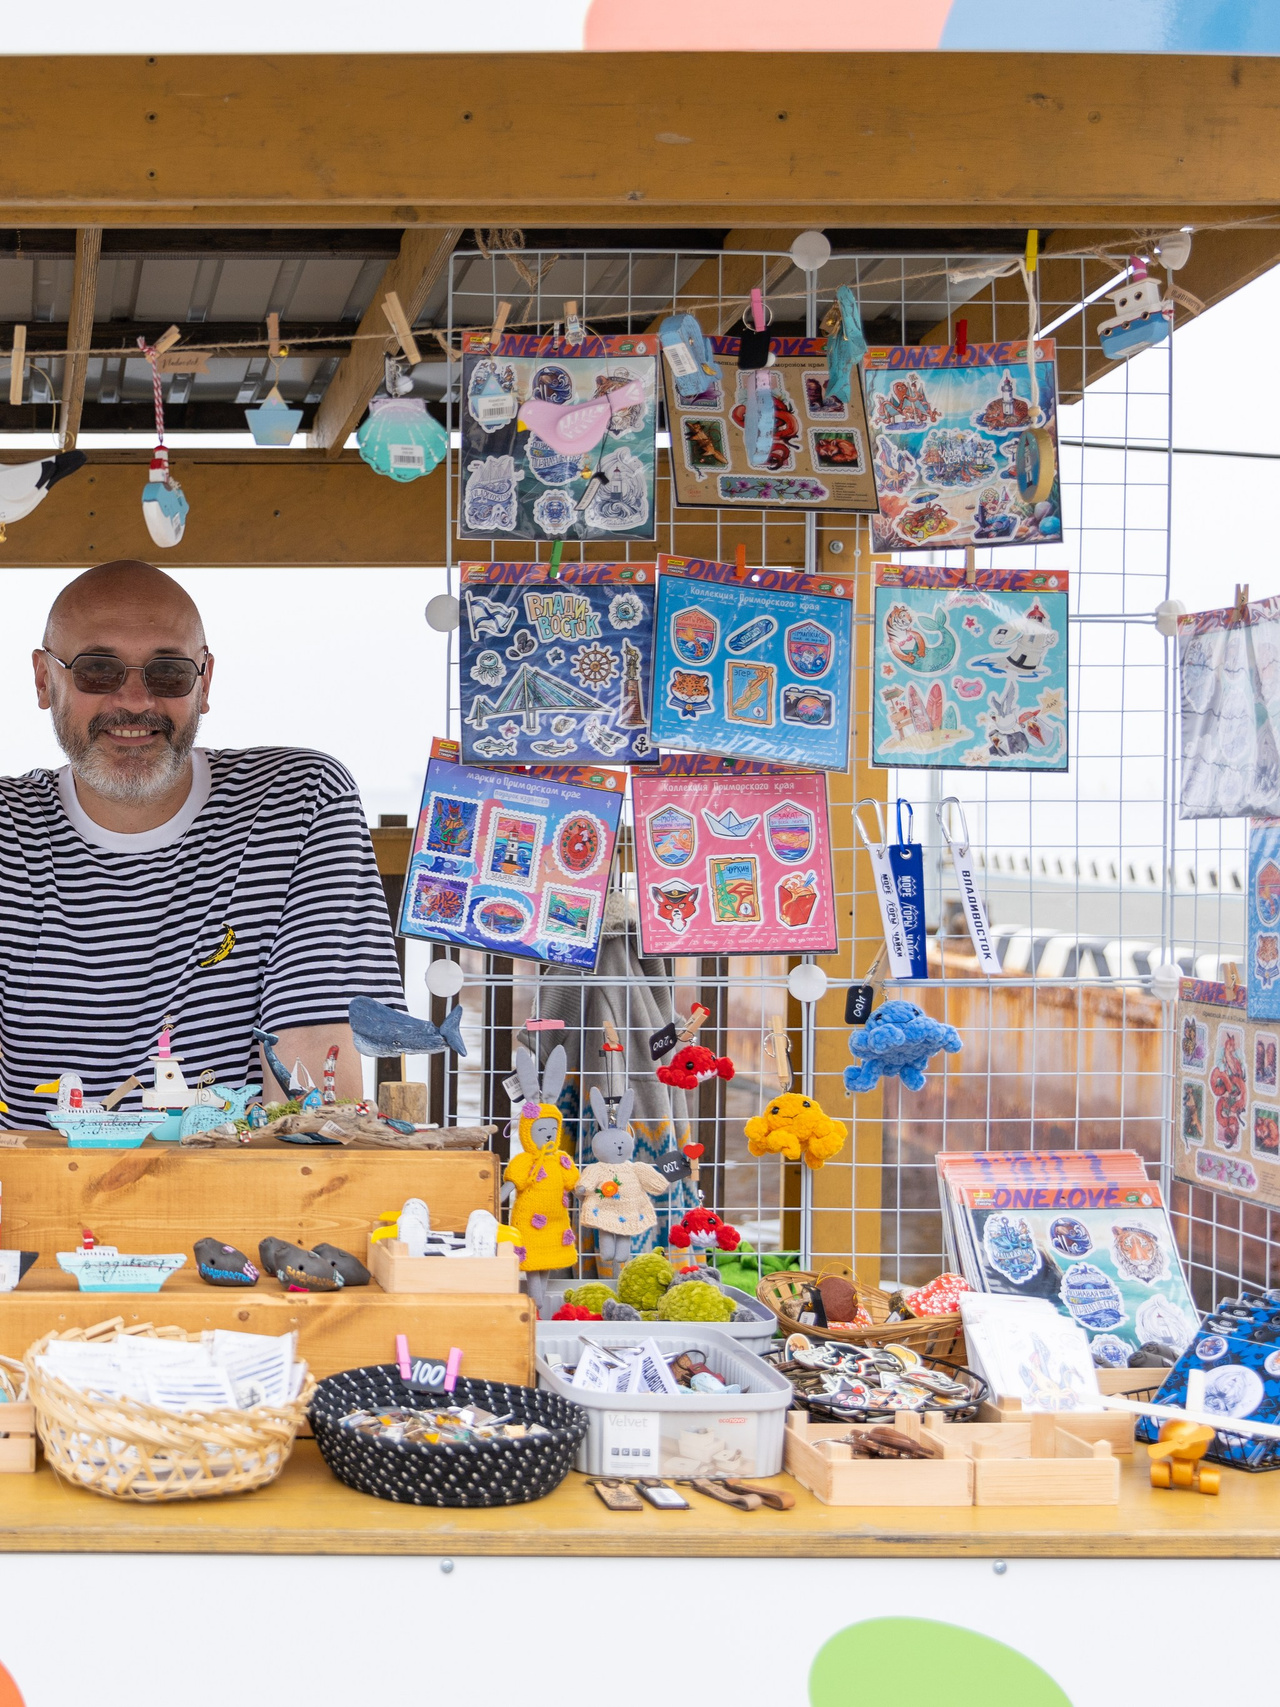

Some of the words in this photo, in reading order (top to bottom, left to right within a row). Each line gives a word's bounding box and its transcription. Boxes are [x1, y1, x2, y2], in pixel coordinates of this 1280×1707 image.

[711, 336, 742, 355] NE
[768, 337, 816, 355] OVE
[888, 345, 941, 368] ONE
[941, 342, 1013, 367] LOVE
[684, 559, 738, 585] ONE
[742, 567, 815, 593] LOVE
[690, 586, 734, 600] Коллекция
[739, 593, 794, 608] Приморского
[799, 602, 820, 613] края
[538, 614, 599, 640] ВОСТОК
[734, 669, 751, 677] ЭГЕР
[503, 777, 558, 794] Приморском
[561, 790, 581, 800] крае
[663, 782, 708, 792] Коллекция
[713, 781, 769, 793] Приморского
[774, 781, 795, 791] края
[725, 865, 750, 874] ЧУРКИН
[881, 873, 892, 894] МОРЕ
[901, 876, 912, 898] МОРЕ
[962, 870, 992, 961] ВЛАДИВОСТОК
[853, 995, 866, 1018] 400
[652, 1035, 670, 1052] 200
[663, 1160, 680, 1173] 200
[993, 1188, 1049, 1208] ONE
[1052, 1187, 1121, 1208] LOVE
[411, 1360, 446, 1386] 100
[609, 1414, 648, 1428] Velvet
